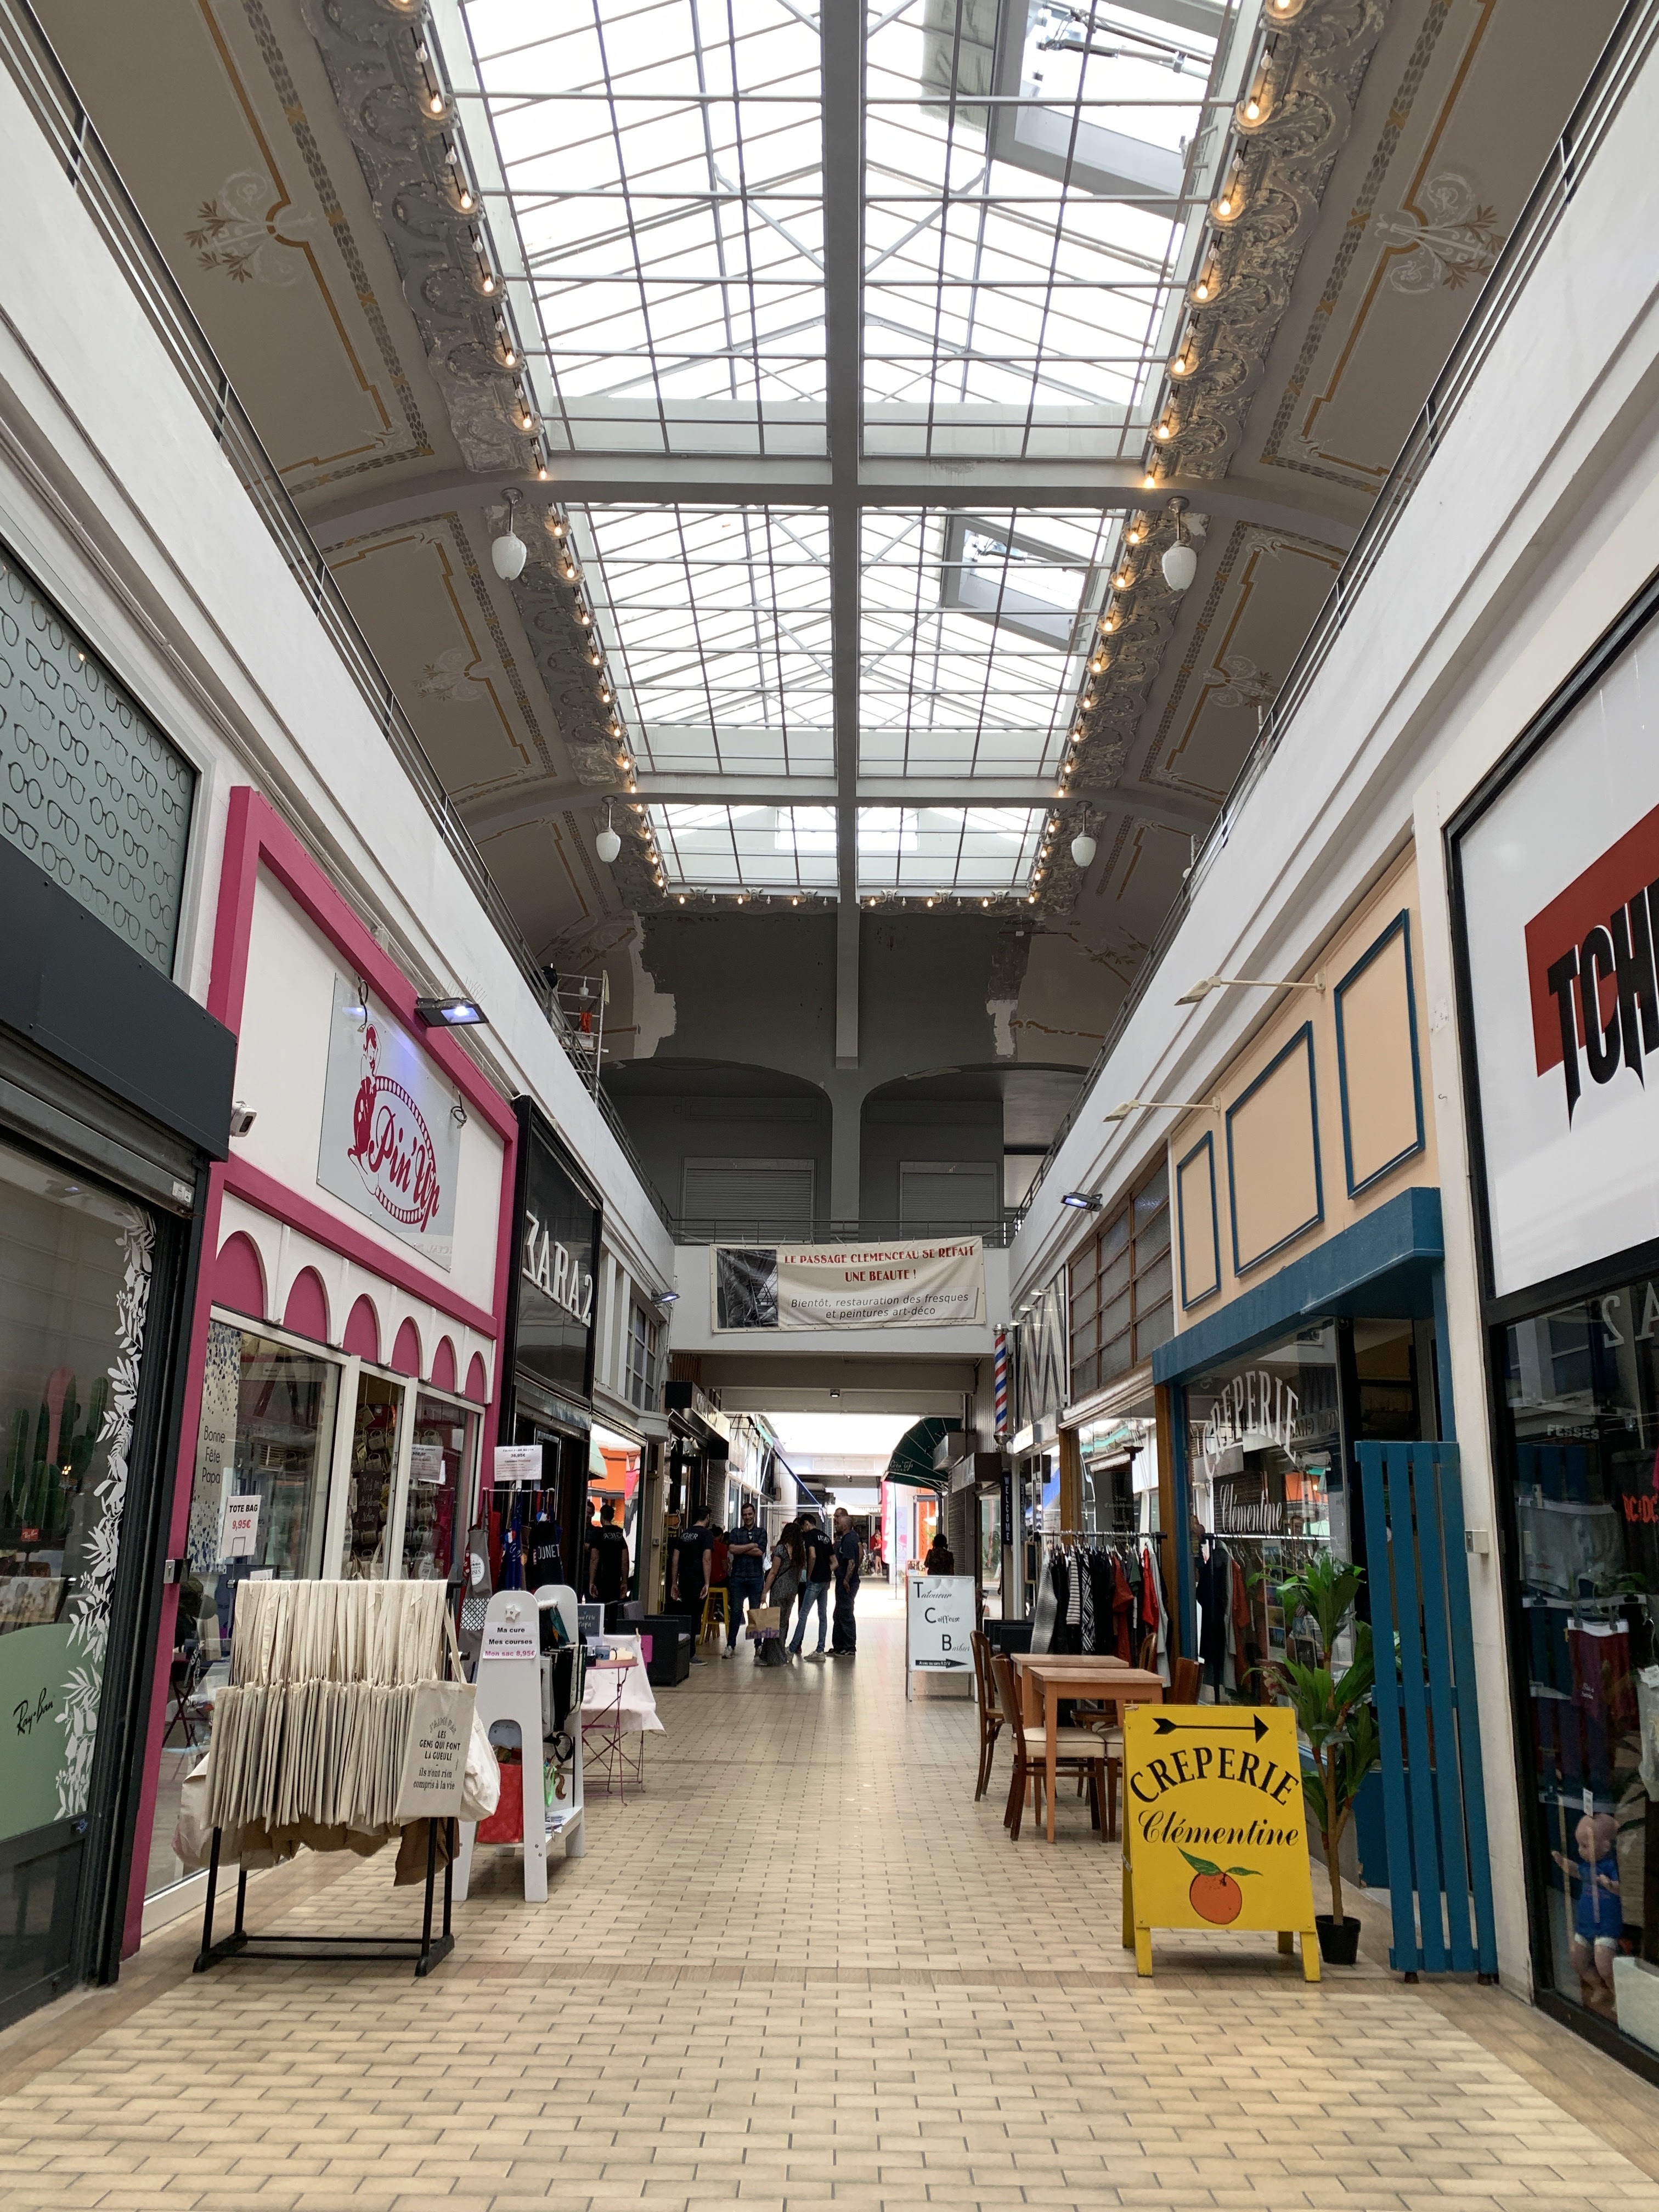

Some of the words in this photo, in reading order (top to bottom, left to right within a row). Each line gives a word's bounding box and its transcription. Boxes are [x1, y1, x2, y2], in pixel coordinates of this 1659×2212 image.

[785, 1255, 797, 1263] LE
[800, 1254, 847, 1263] PASSAGE
[850, 1250, 919, 1263] CLEMENCEAU
[922, 1249, 935, 1259] SE
[939, 1245, 974, 1257] REFAIT
[845, 1271, 866, 1282] UNE
[869, 1269, 910, 1281] BEAUTE
[913, 1269, 916, 1279] !
[791, 1298, 832, 1308] Bientôt,
[836, 1296, 899, 1307] restauration
[903, 1295, 921, 1305] des
[924, 1294, 969, 1305] fresques
[839, 1308, 889, 1319] peintures
[893, 1306, 936, 1316] art-déco
[1203, 1370, 1299, 1481] CREPERIE
[204, 1425, 225, 1443] Bonne
[205, 1446, 221, 1463] Fête
[202, 1467, 221, 1484] Papa
[229, 1505, 244, 1513] TOTE
[1220, 1483, 1282, 1534] Clémentine
[232, 1519, 251, 1531] 9,95€
[913, 1582, 952, 1599] Tatoueur
[924, 1607, 961, 1624] Coiffeuse
[437, 1730, 447, 1739] LES
[419, 1739, 433, 1748] GENS
[435, 1740, 445, 1750] QUI
[446, 1742, 461, 1751] FONT
[425, 1751, 431, 1759] LA
[433, 1752, 453, 1761] GUEULE
[427, 1768, 441, 1778] n'ont
[441, 1769, 452, 1778] rien
[1130, 1747, 1300, 1806] CREPERIE
[413, 1780, 435, 1791] compris
[435, 1780, 439, 1790] à
[440, 1780, 446, 1790] la
[447, 1781, 455, 1790] vie
[1138, 1810, 1299, 1846] Clémentine
